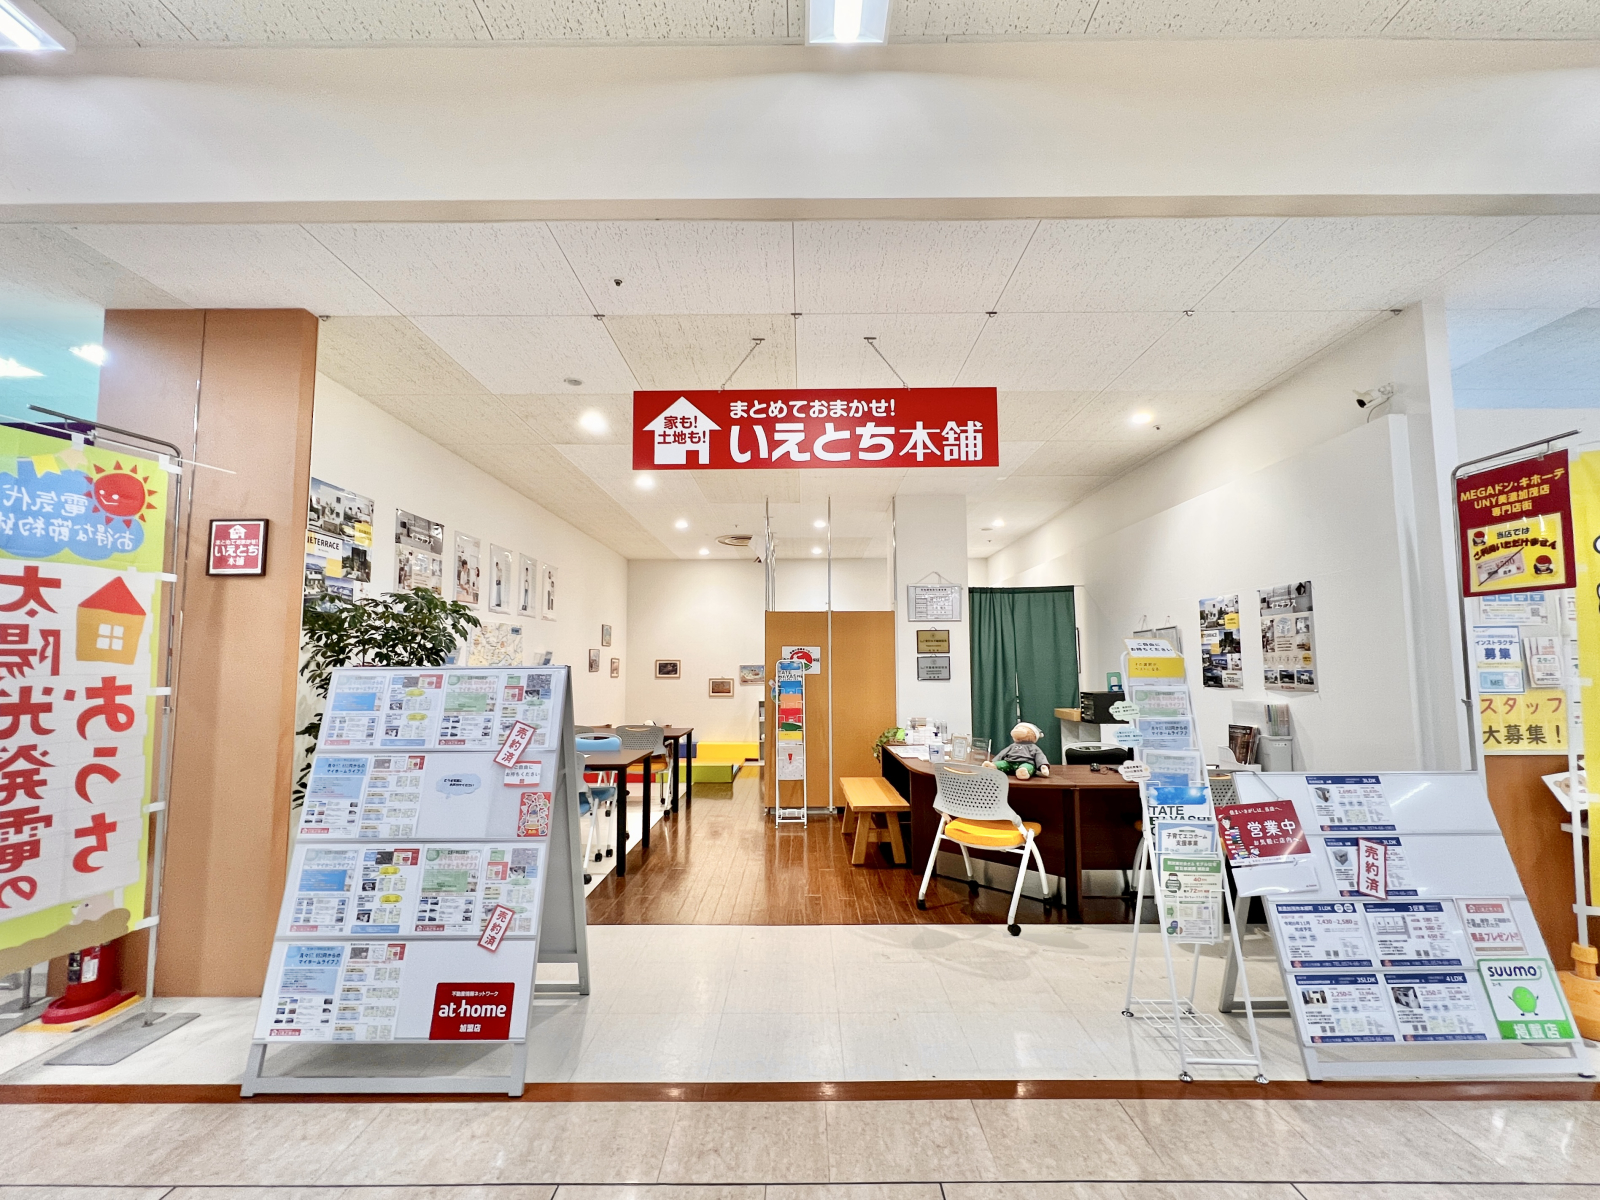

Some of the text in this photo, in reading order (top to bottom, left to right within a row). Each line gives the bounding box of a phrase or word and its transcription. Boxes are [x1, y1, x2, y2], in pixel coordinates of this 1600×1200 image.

[729, 399, 896, 419] まとめておまかせ!
[663, 414, 698, 429] 家も!
[657, 430, 708, 445] 土地も!
[729, 420, 984, 463] いえとち本舗
[1460, 468, 1565, 502] MEGAドン・キホーテ
[1474, 484, 1550, 509] UNY美濃加茂店
[1491, 499, 1532, 517] 専門店街
[1496, 527, 1530, 540] 当店では
[214, 545, 259, 557] いえとち
[1473, 537, 1557, 561] ご利用いただけません
[227, 556, 245, 566] 本舗
[1484, 647, 1511, 660] 募集
[1480, 697, 1563, 715] スタッフ
[1482, 724, 1561, 745] 大募集！
[501, 726, 529, 764] 売約済
[1246, 818, 1296, 838] 営業中
[1364, 845, 1380, 894] 売約済
[484, 910, 509, 947] 売約済
[458, 1023, 482, 1033] 加盟店
[1513, 1022, 1561, 1039] 掲載店
